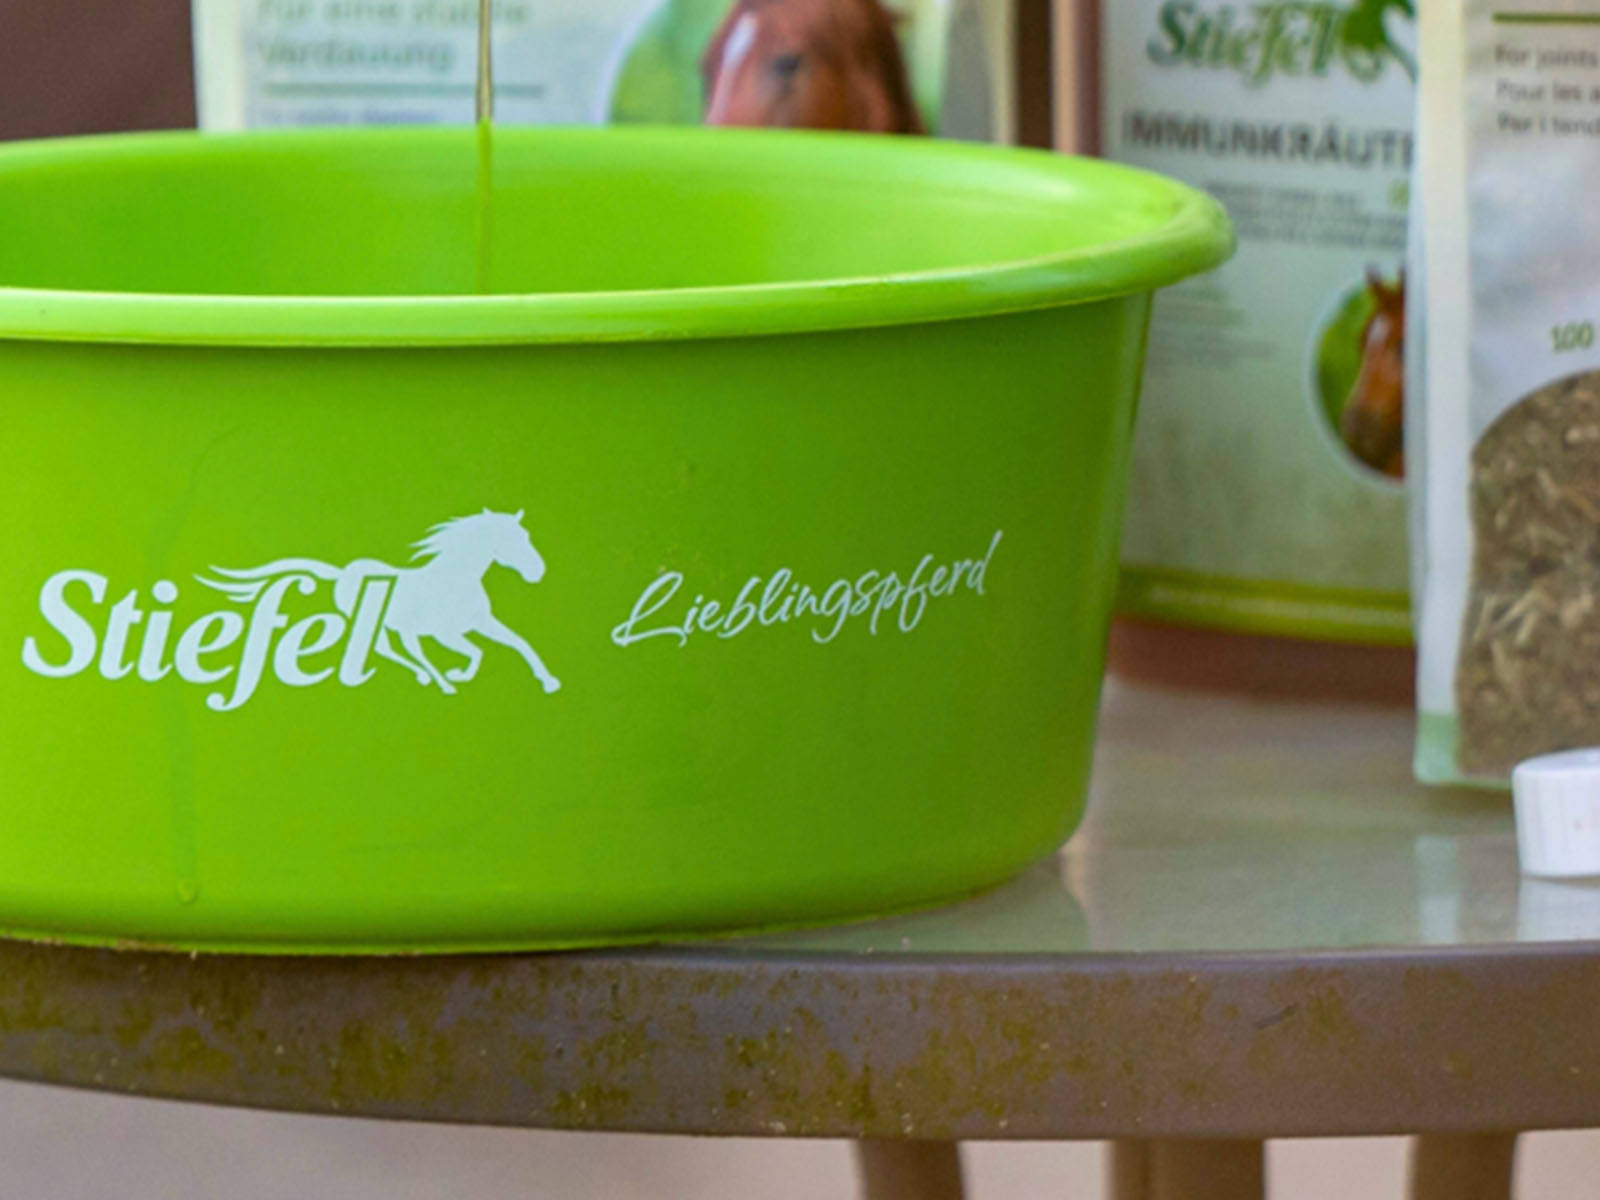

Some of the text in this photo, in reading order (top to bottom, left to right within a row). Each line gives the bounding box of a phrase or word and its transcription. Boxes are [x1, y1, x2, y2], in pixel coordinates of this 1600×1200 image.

[1550, 320, 1595, 355] 100
[21, 567, 398, 712] Stiefel
[610, 530, 1003, 648] Lieblingspferd
